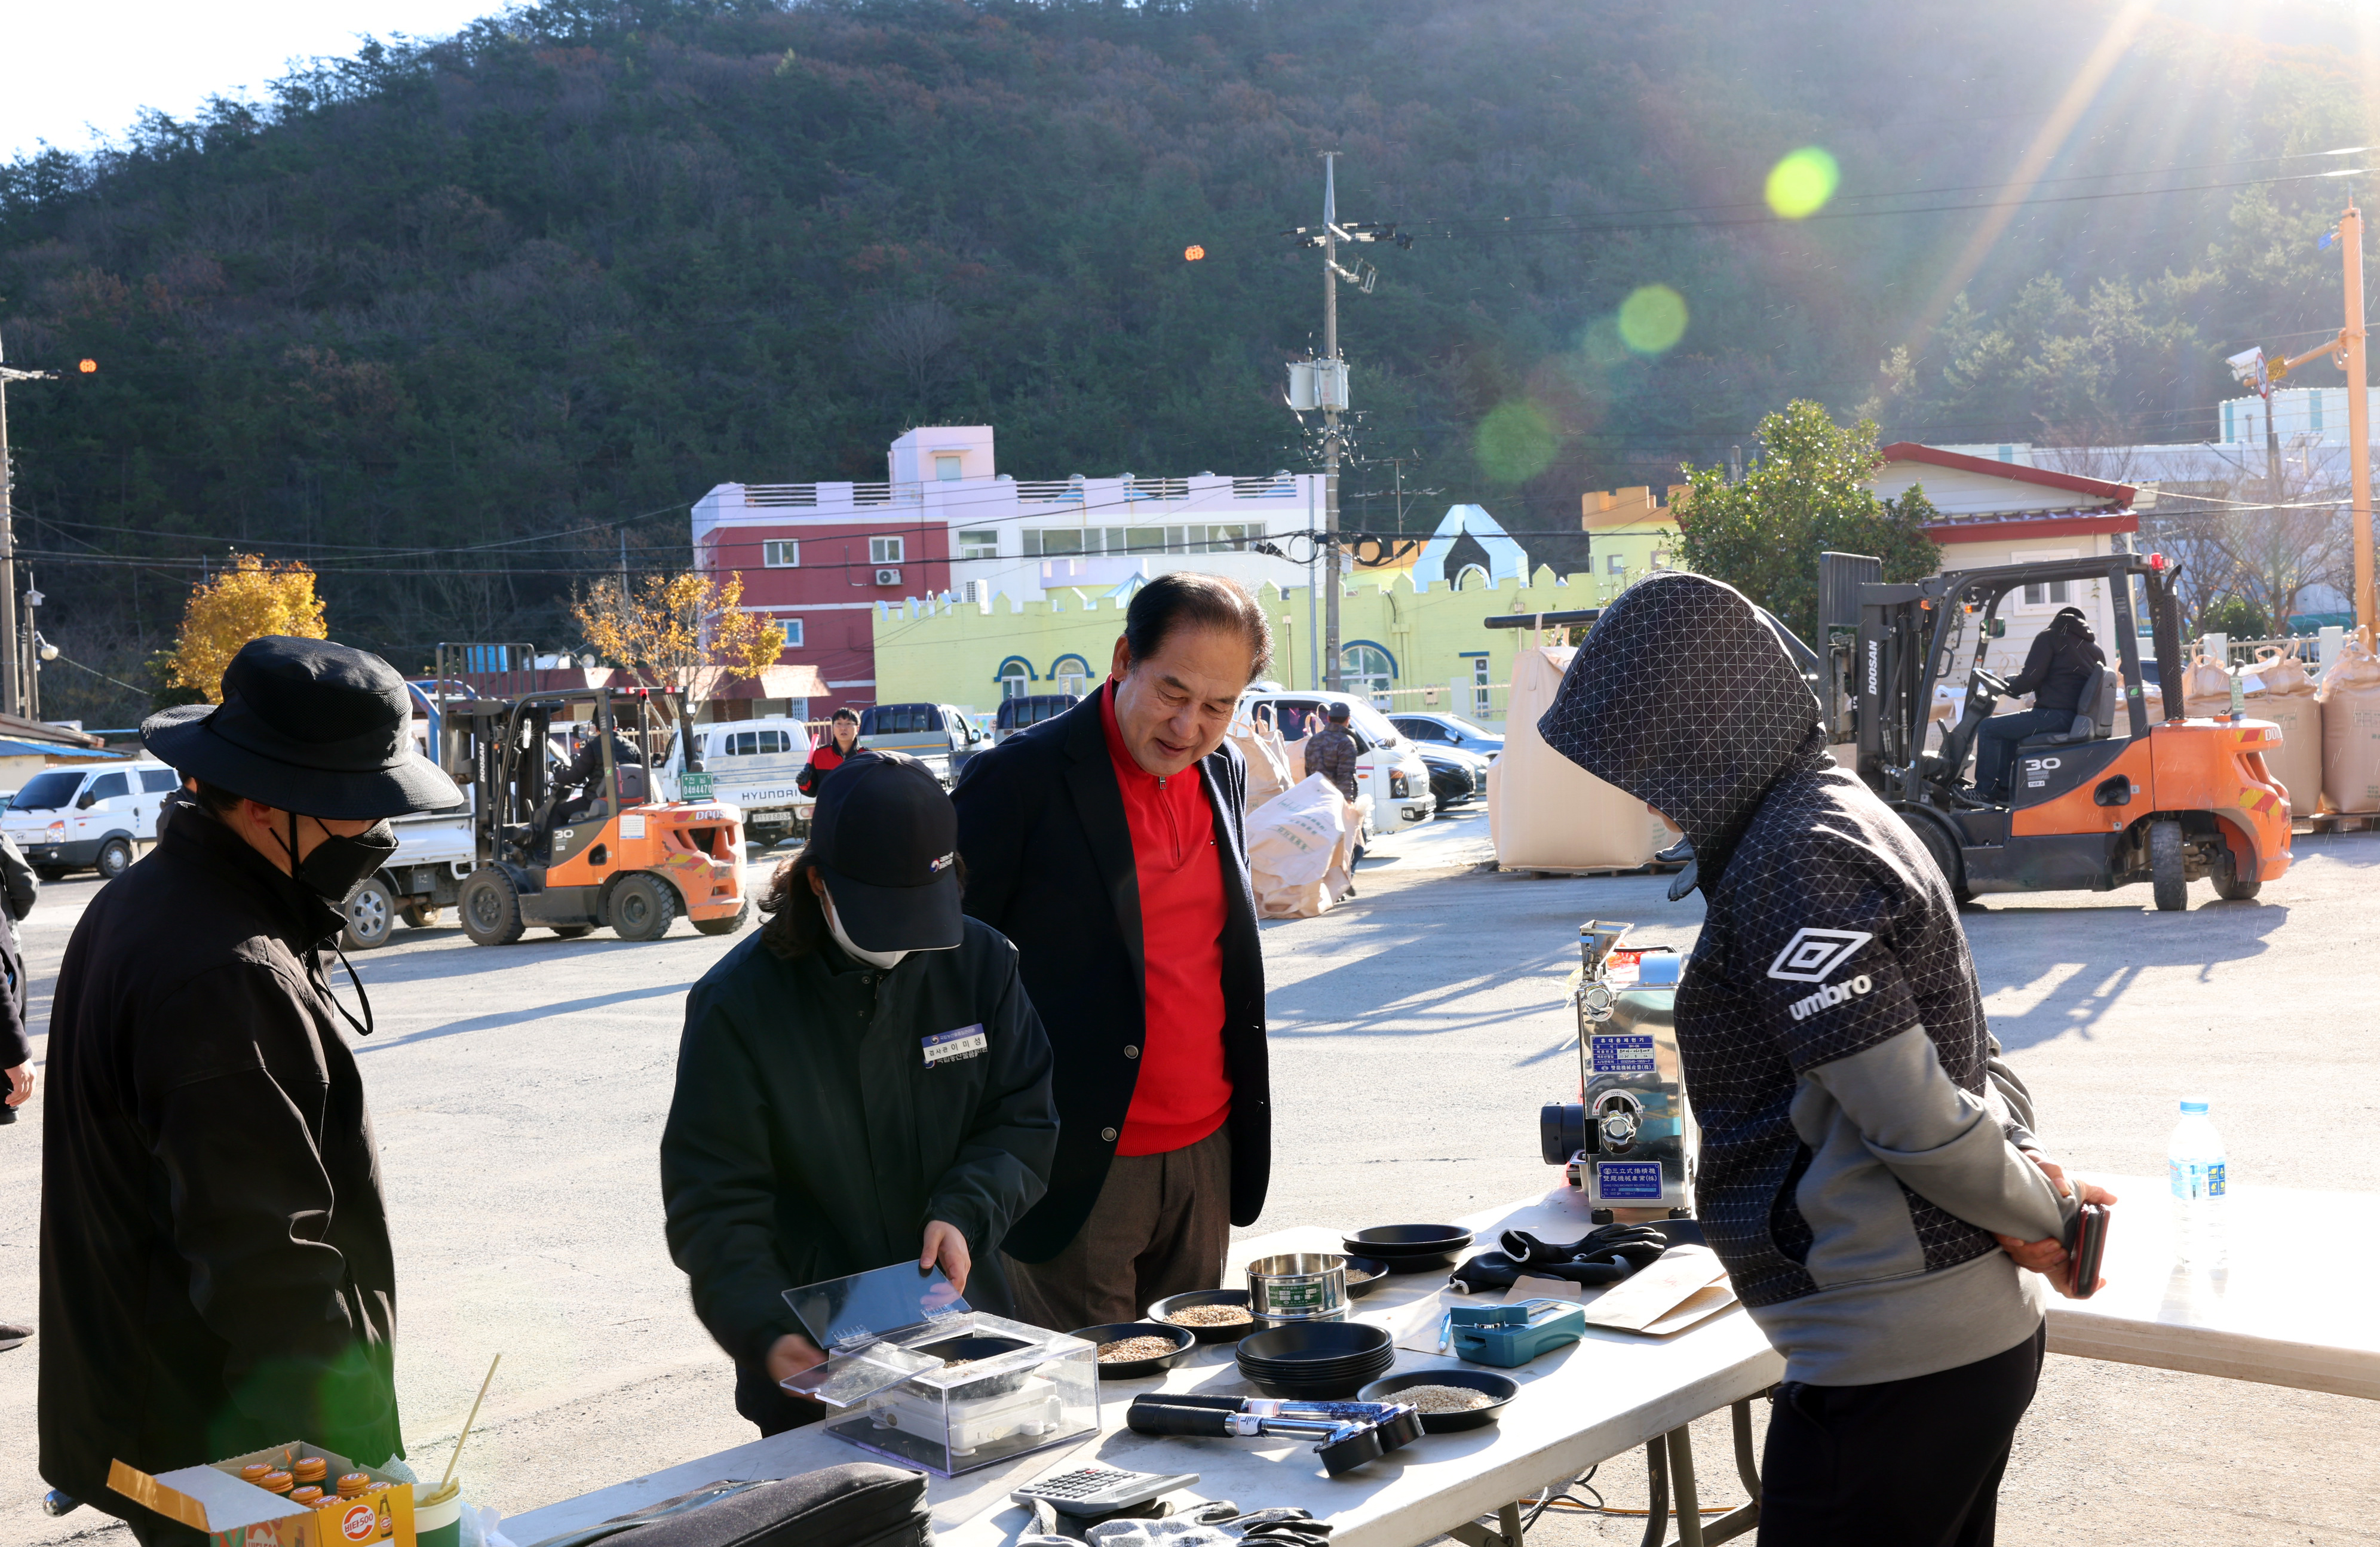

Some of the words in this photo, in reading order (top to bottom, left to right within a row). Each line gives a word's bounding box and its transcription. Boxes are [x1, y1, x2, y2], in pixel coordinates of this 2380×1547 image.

[1868, 640, 1877, 695] DOOSAN
[2025, 757, 2061, 771] 30
[742, 789, 798, 800] HYUNDAI
[554, 829, 574, 839] 30
[1789, 975, 1872, 1020] umbro
[929, 1046, 948, 1056] 검사관
[345, 1513, 373, 1533] 비타500
